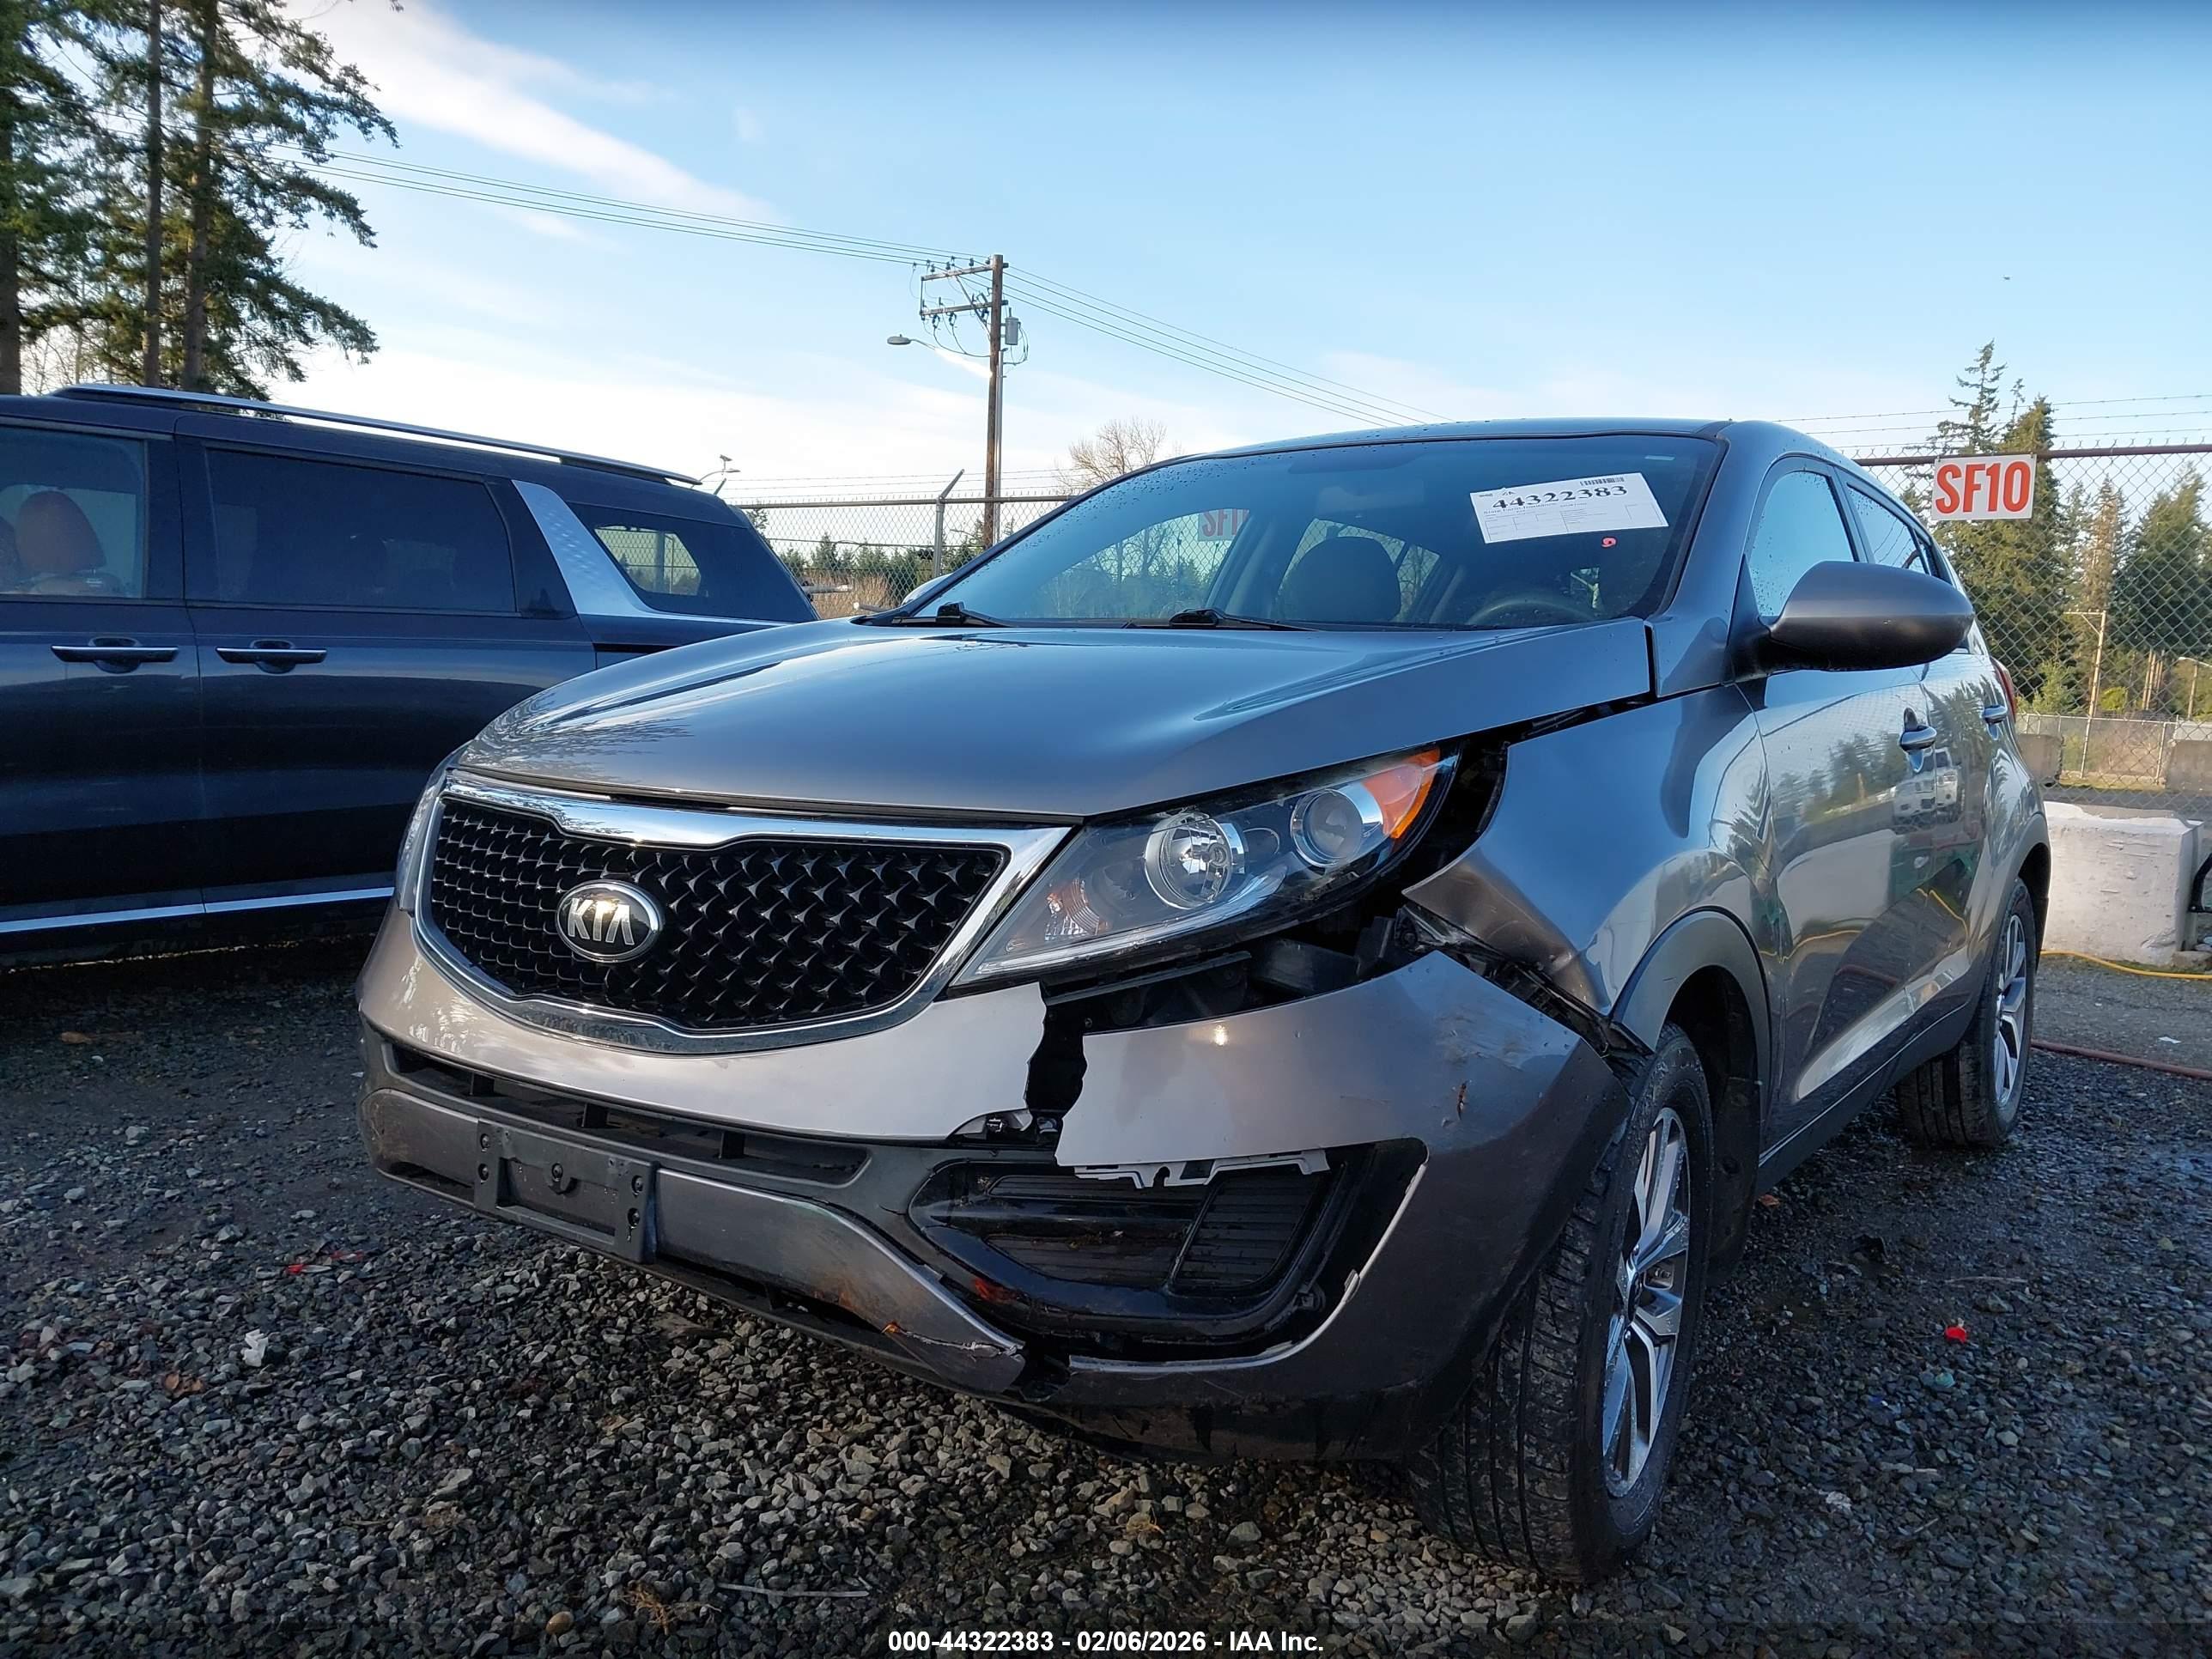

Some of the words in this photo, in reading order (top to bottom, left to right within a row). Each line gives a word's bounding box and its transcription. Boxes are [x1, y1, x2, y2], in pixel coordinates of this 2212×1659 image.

[1492, 485, 1627, 509] 44322383
[1936, 461, 2031, 514] SF10
[1201, 508, 1249, 538] SF1
[567, 897, 635, 946] KIA
